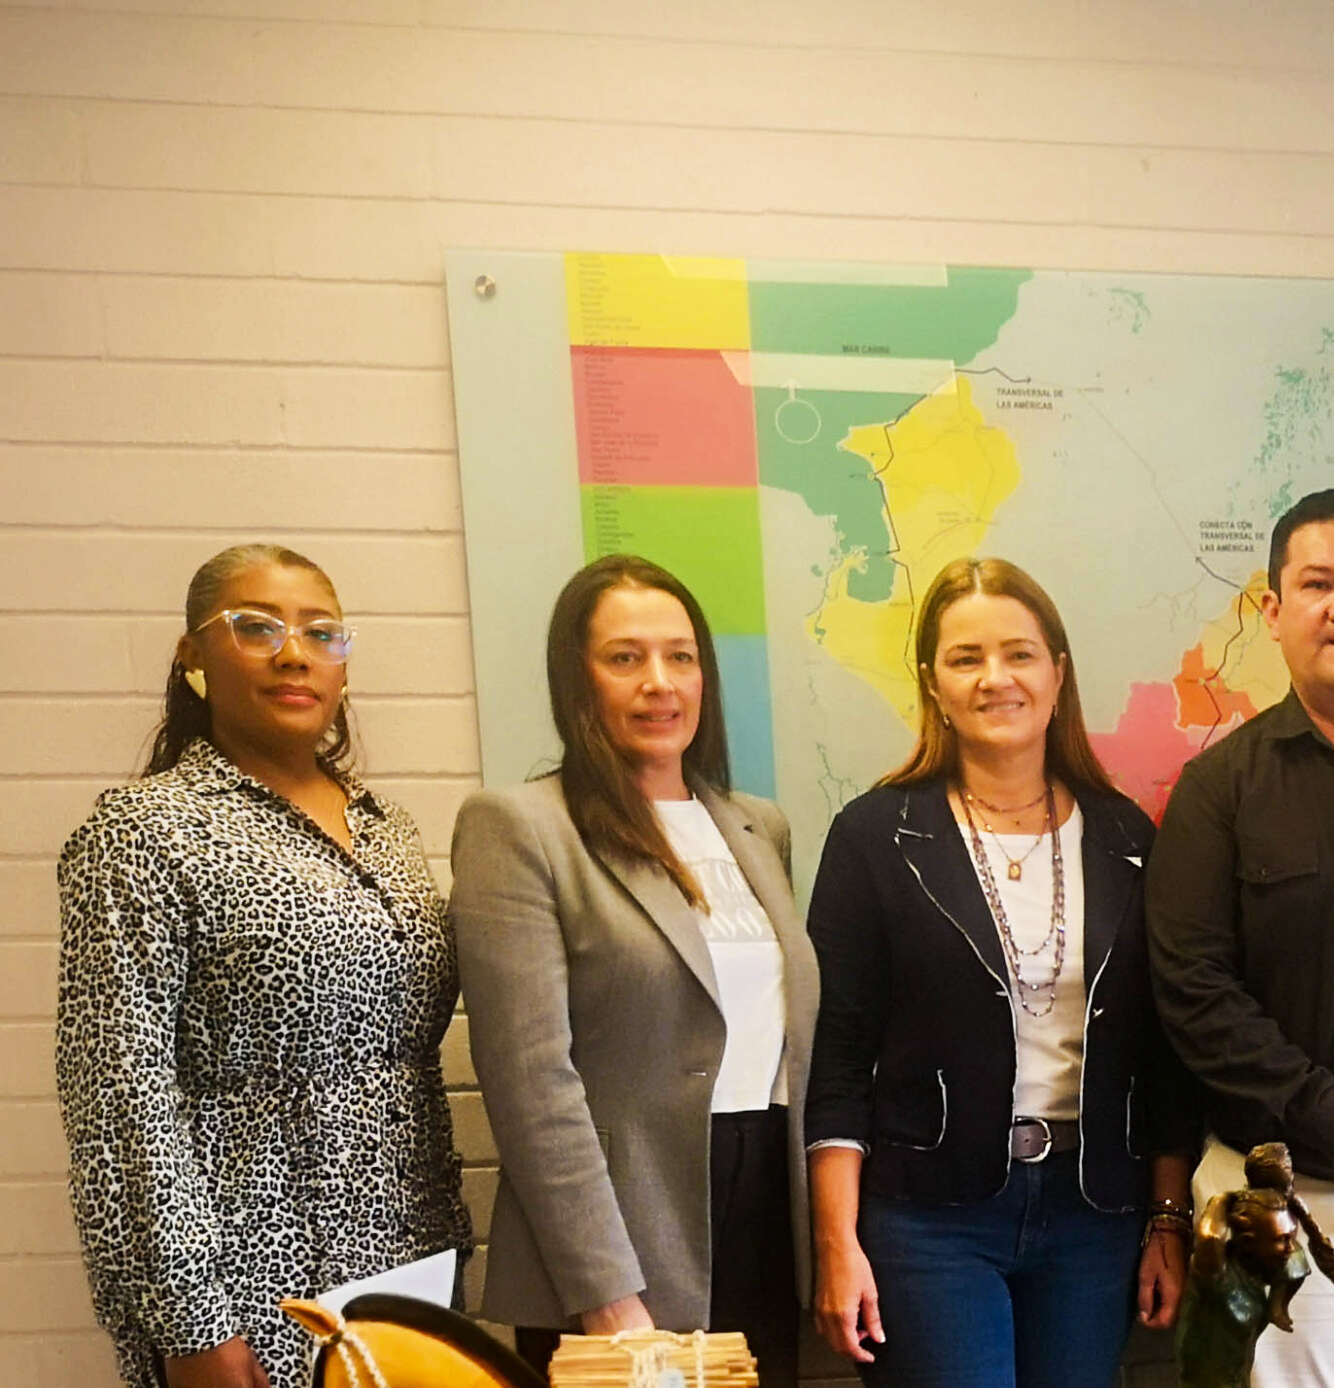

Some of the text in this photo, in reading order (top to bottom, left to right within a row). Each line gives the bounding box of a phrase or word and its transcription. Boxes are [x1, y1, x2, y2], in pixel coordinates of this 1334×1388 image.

[997, 388, 1063, 398] TRANSVERSAL DE
[996, 401, 1011, 409] LAS
[1200, 521, 1235, 530] CONECTA
[1200, 532, 1266, 540] TRANSVERSAL DE
[1200, 544, 1214, 552] LAS
